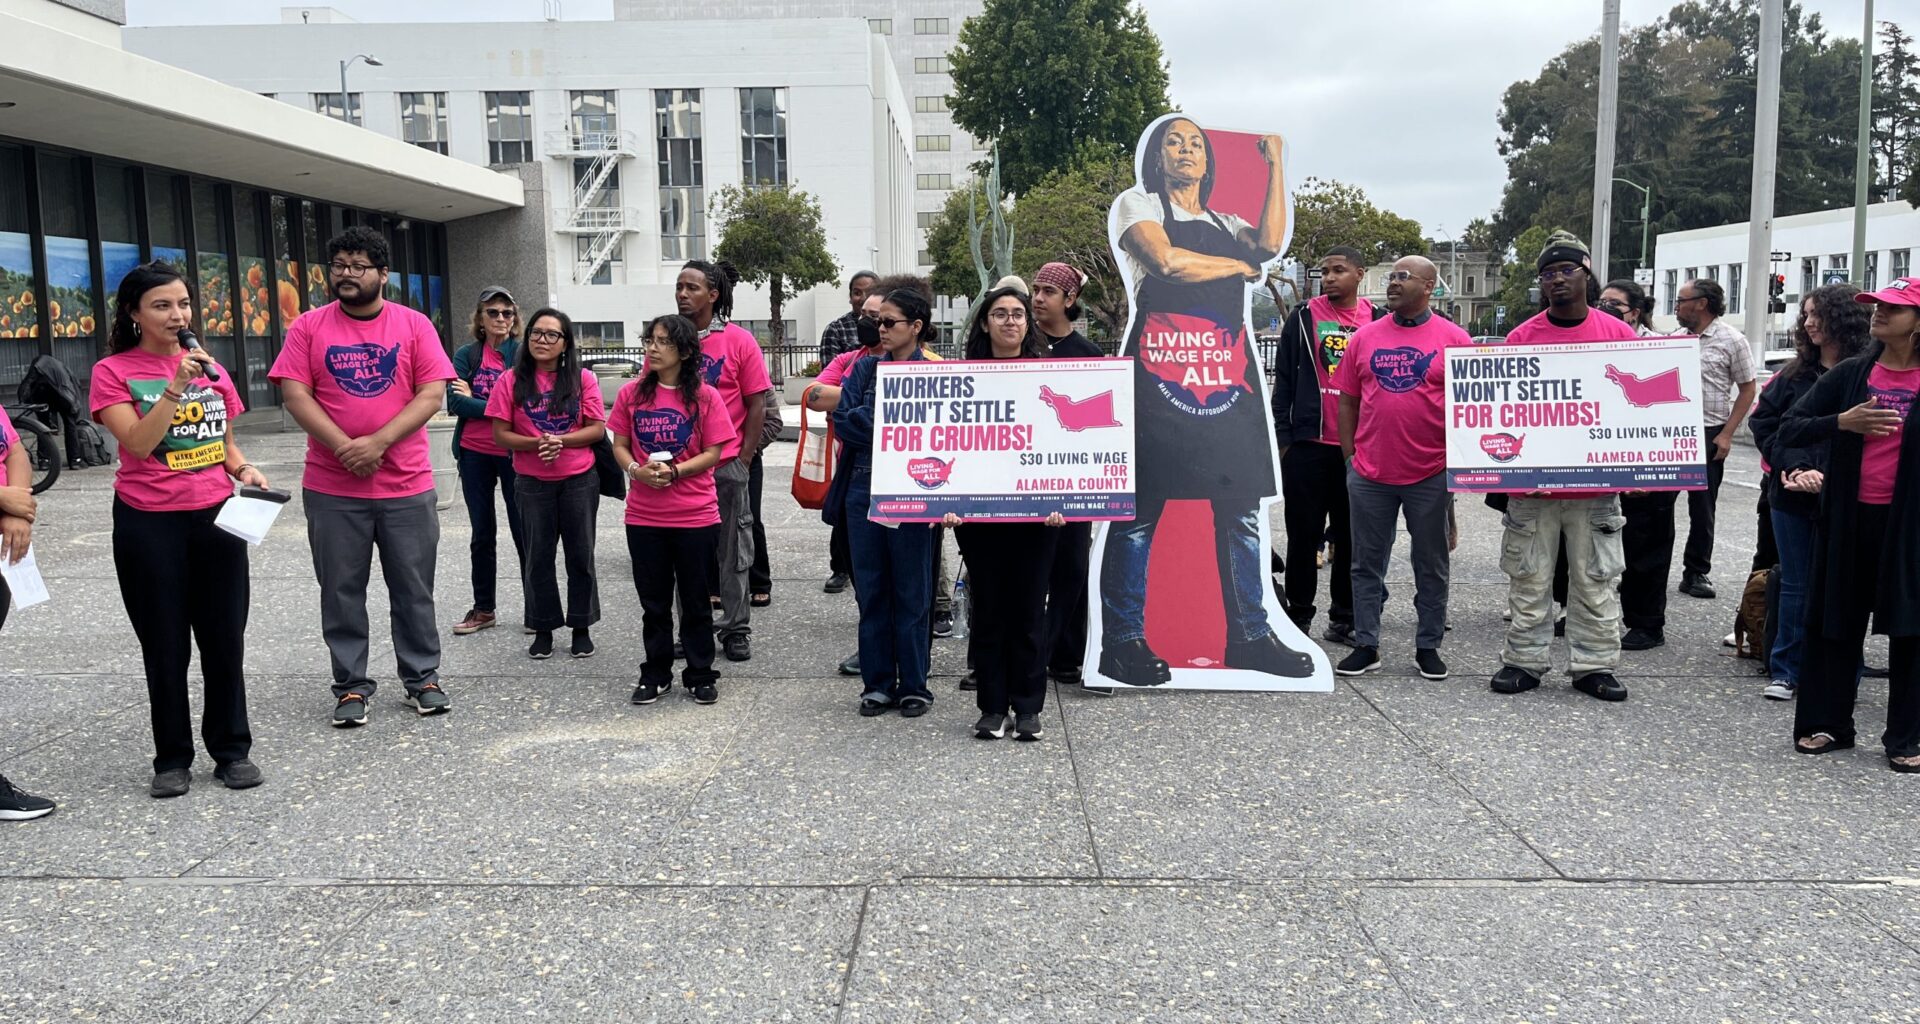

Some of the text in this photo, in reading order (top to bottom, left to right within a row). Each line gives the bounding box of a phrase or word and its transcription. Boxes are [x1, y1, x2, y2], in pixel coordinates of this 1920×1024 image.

[1146, 332, 1216, 347] LIVING
[330, 353, 369, 362] LIVING
[1148, 350, 1232, 362] WAGE FOR
[1375, 354, 1407, 363] LIVING
[333, 358, 380, 370] WAGE FOR
[1451, 357, 1540, 380] WORKERS
[354, 366, 381, 379] ALL
[1182, 366, 1232, 386] ALL
[1391, 367, 1414, 377] ALL
[882, 376, 974, 400] WORKERS
[1452, 379, 1582, 402] WON'T SETTLE
[1158, 382, 1240, 416] MAKE AMERICA AFFORDABLE NOW
[171, 402, 204, 424] 30
[204, 410, 227, 421] WAG
[882, 400, 1015, 424] WON'T SETTLE
[1453, 401, 1600, 428] FOR CRUMBS!
[636, 417, 669, 426] LIVING
[173, 424, 198, 437] FOR
[1589, 426, 1697, 440] $30 LIVING WAGE
[654, 432, 677, 443] ALL
[881, 424, 1033, 452] FOR CRUMBS!
[1673, 438, 1697, 449] FOR
[174, 444, 222, 461] MAKE AMERICA
[1020, 452, 1127, 466] $30 LIVING WAGE
[1586, 450, 1698, 463] ALAMEDA COUNTY
[1104, 465, 1127, 476] FOR
[1016, 478, 1127, 491] ALAMEDA COUNTY
